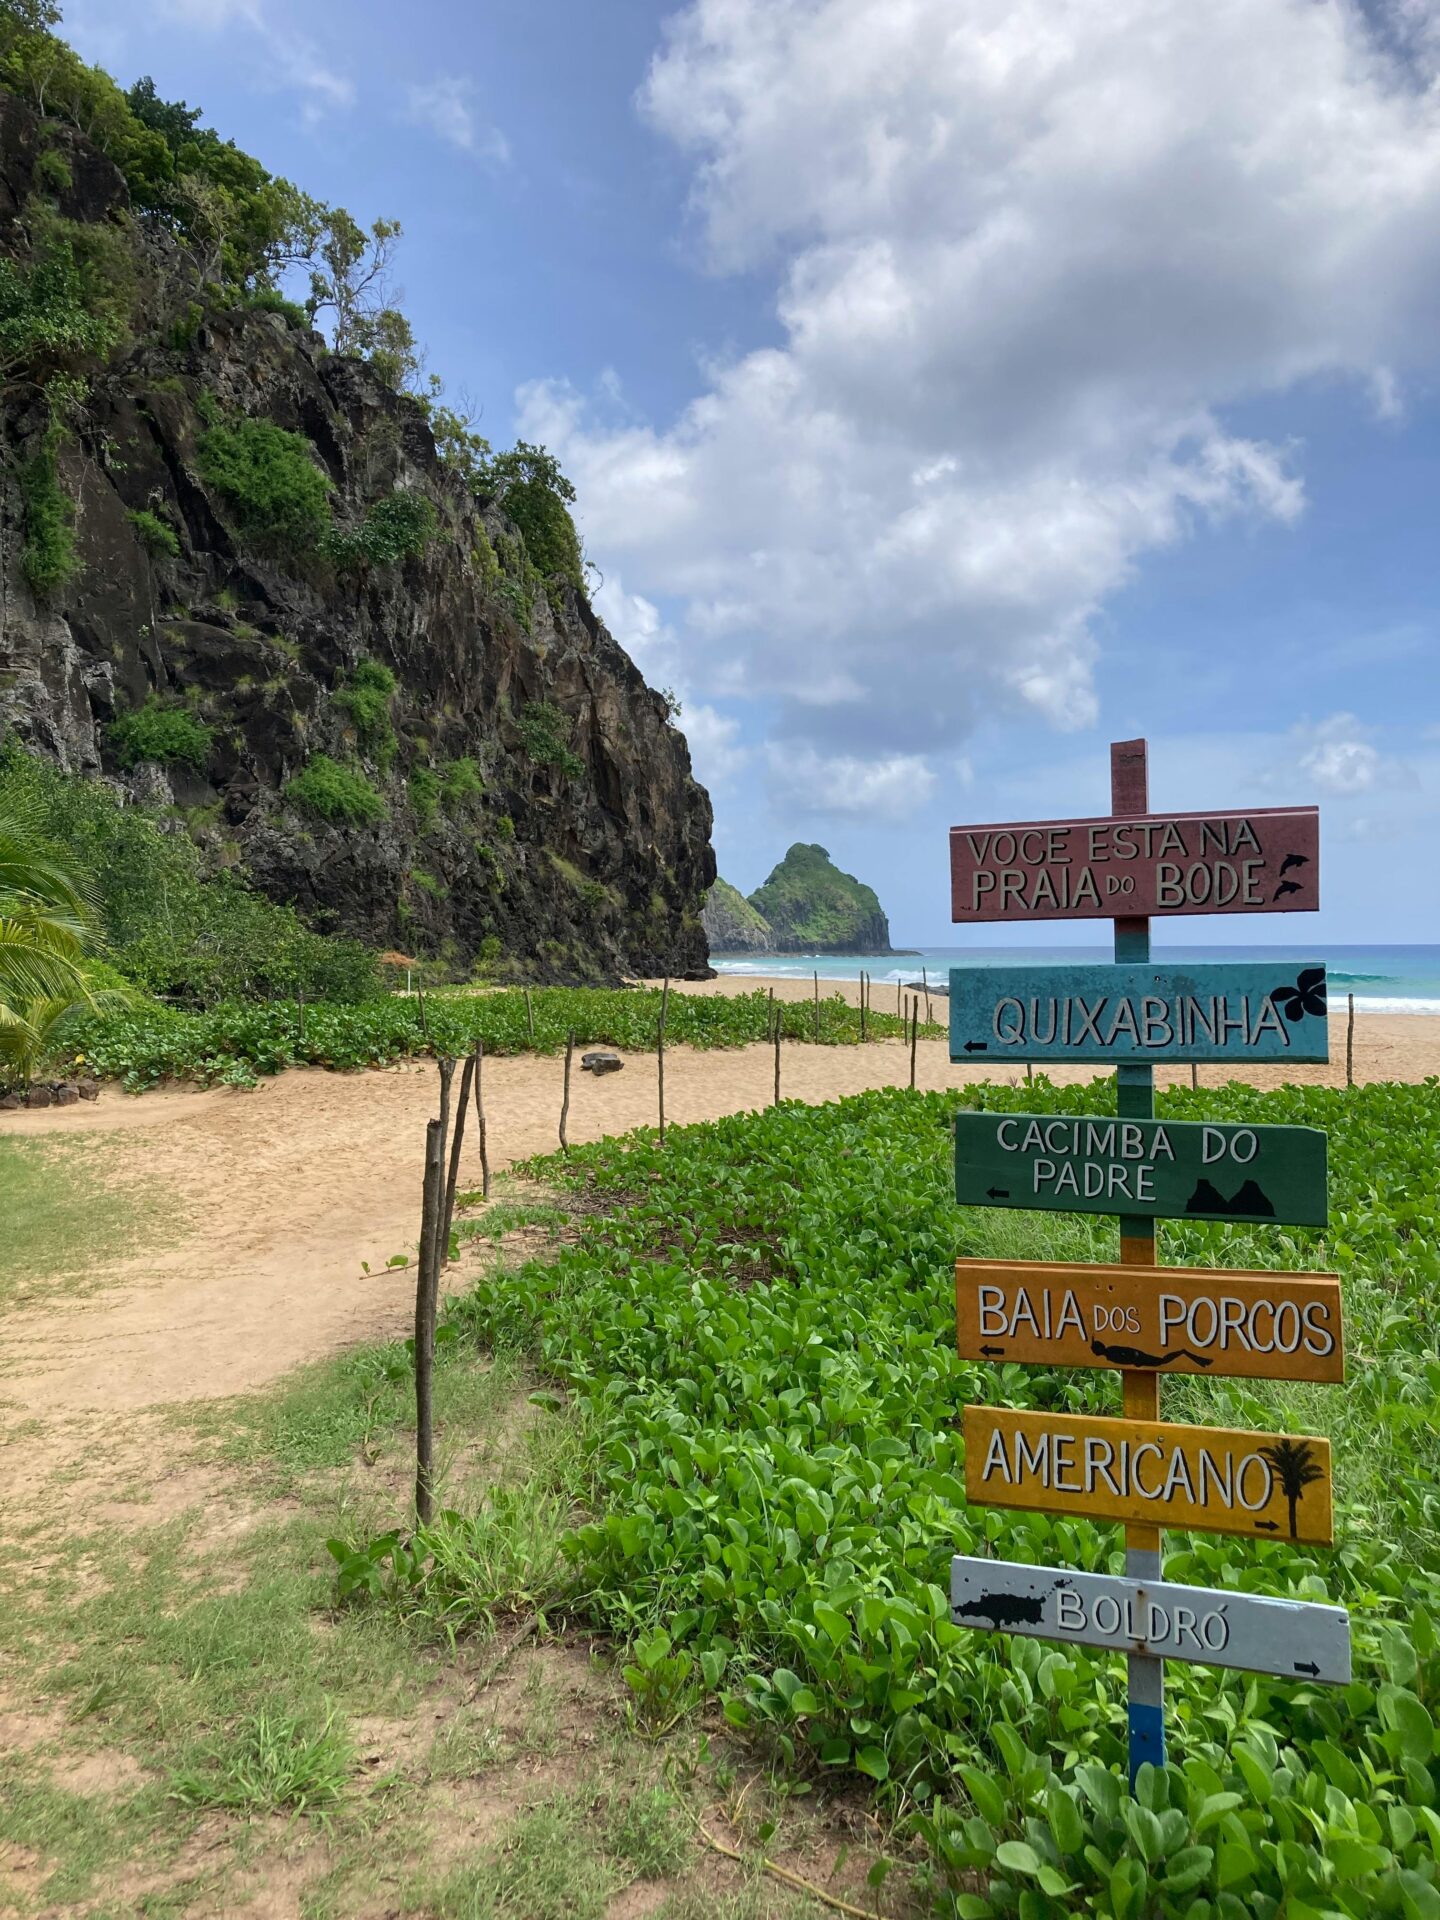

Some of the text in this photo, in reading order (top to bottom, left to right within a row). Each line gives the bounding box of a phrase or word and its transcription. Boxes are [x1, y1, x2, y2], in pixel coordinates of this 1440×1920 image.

[966, 828, 1072, 866] VOCE
[1200, 818, 1262, 856] NA
[972, 859, 1265, 911] PRAIA DO BODE
[992, 996, 1290, 1047] QUIXABINHA
[997, 1119, 1259, 1164] CACIMBA DO
[1033, 1158, 1157, 1201] PADRE
[978, 1285, 1334, 1357] BAIA DOS PORCOS
[982, 1428, 1274, 1511] AMERICANO
[1056, 1588, 1230, 1652] BOLDRÓ
